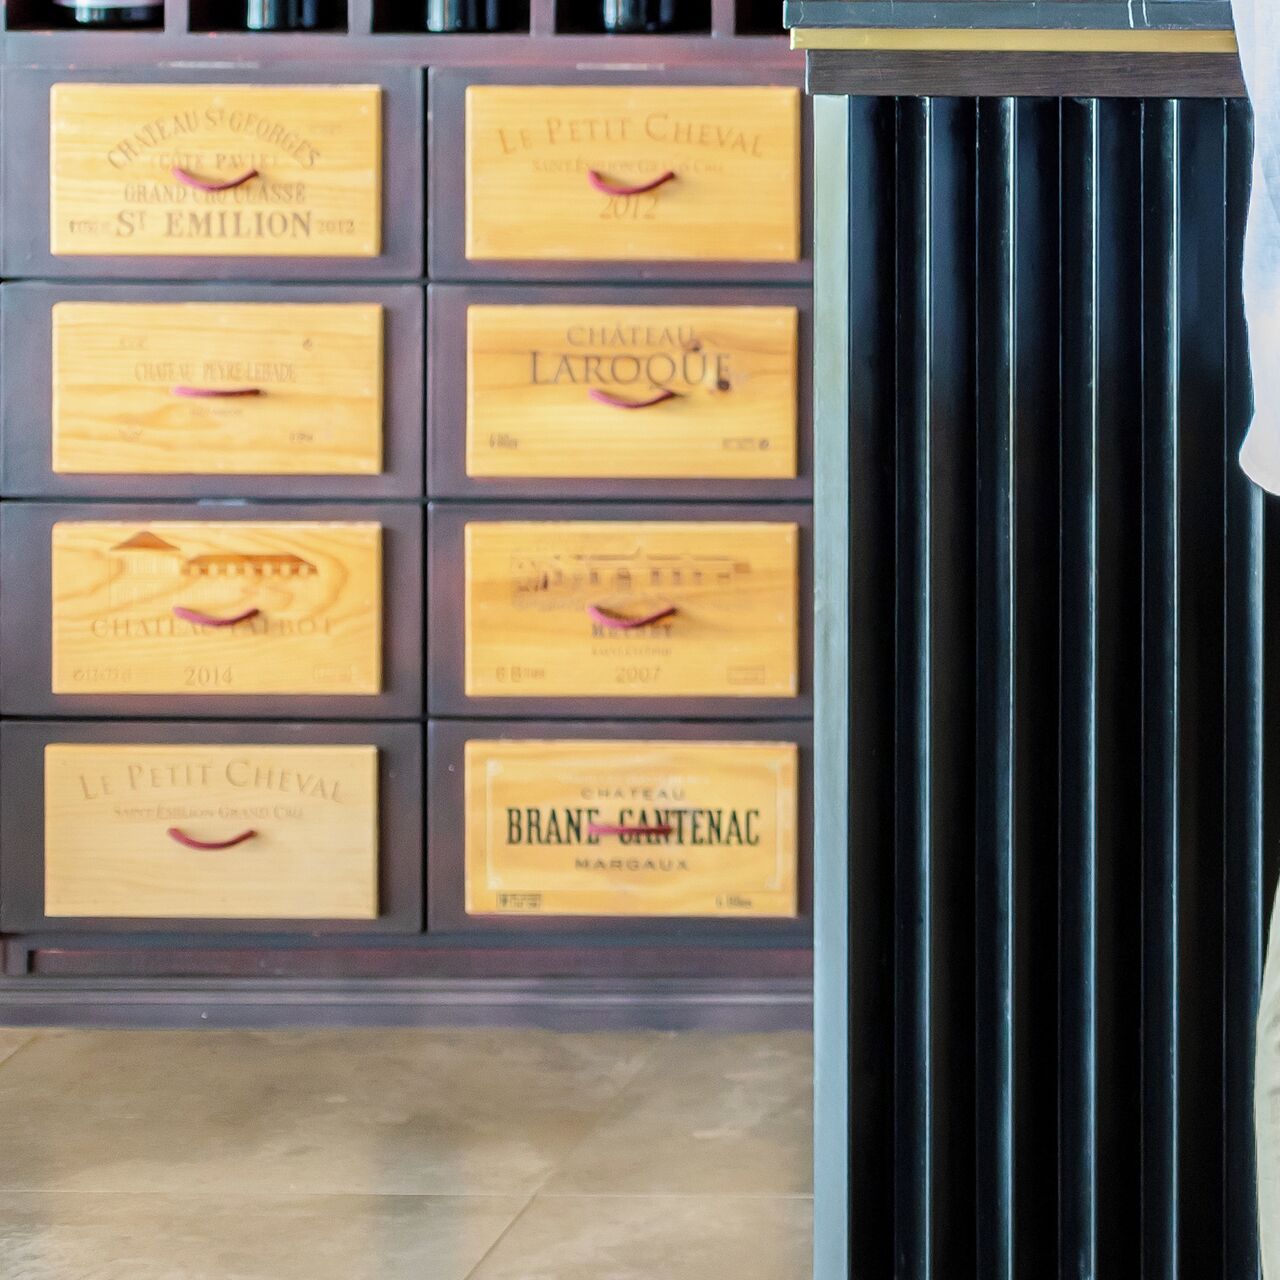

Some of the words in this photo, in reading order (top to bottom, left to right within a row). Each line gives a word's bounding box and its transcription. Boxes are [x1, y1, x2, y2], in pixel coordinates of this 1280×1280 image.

[229, 110, 321, 169] GEORGES
[125, 183, 187, 204] GRAND
[164, 210, 312, 238] EMILION
[529, 350, 732, 389] LAROQUE
[184, 667, 232, 686] 2014
[575, 858, 688, 871] MARGAUX
